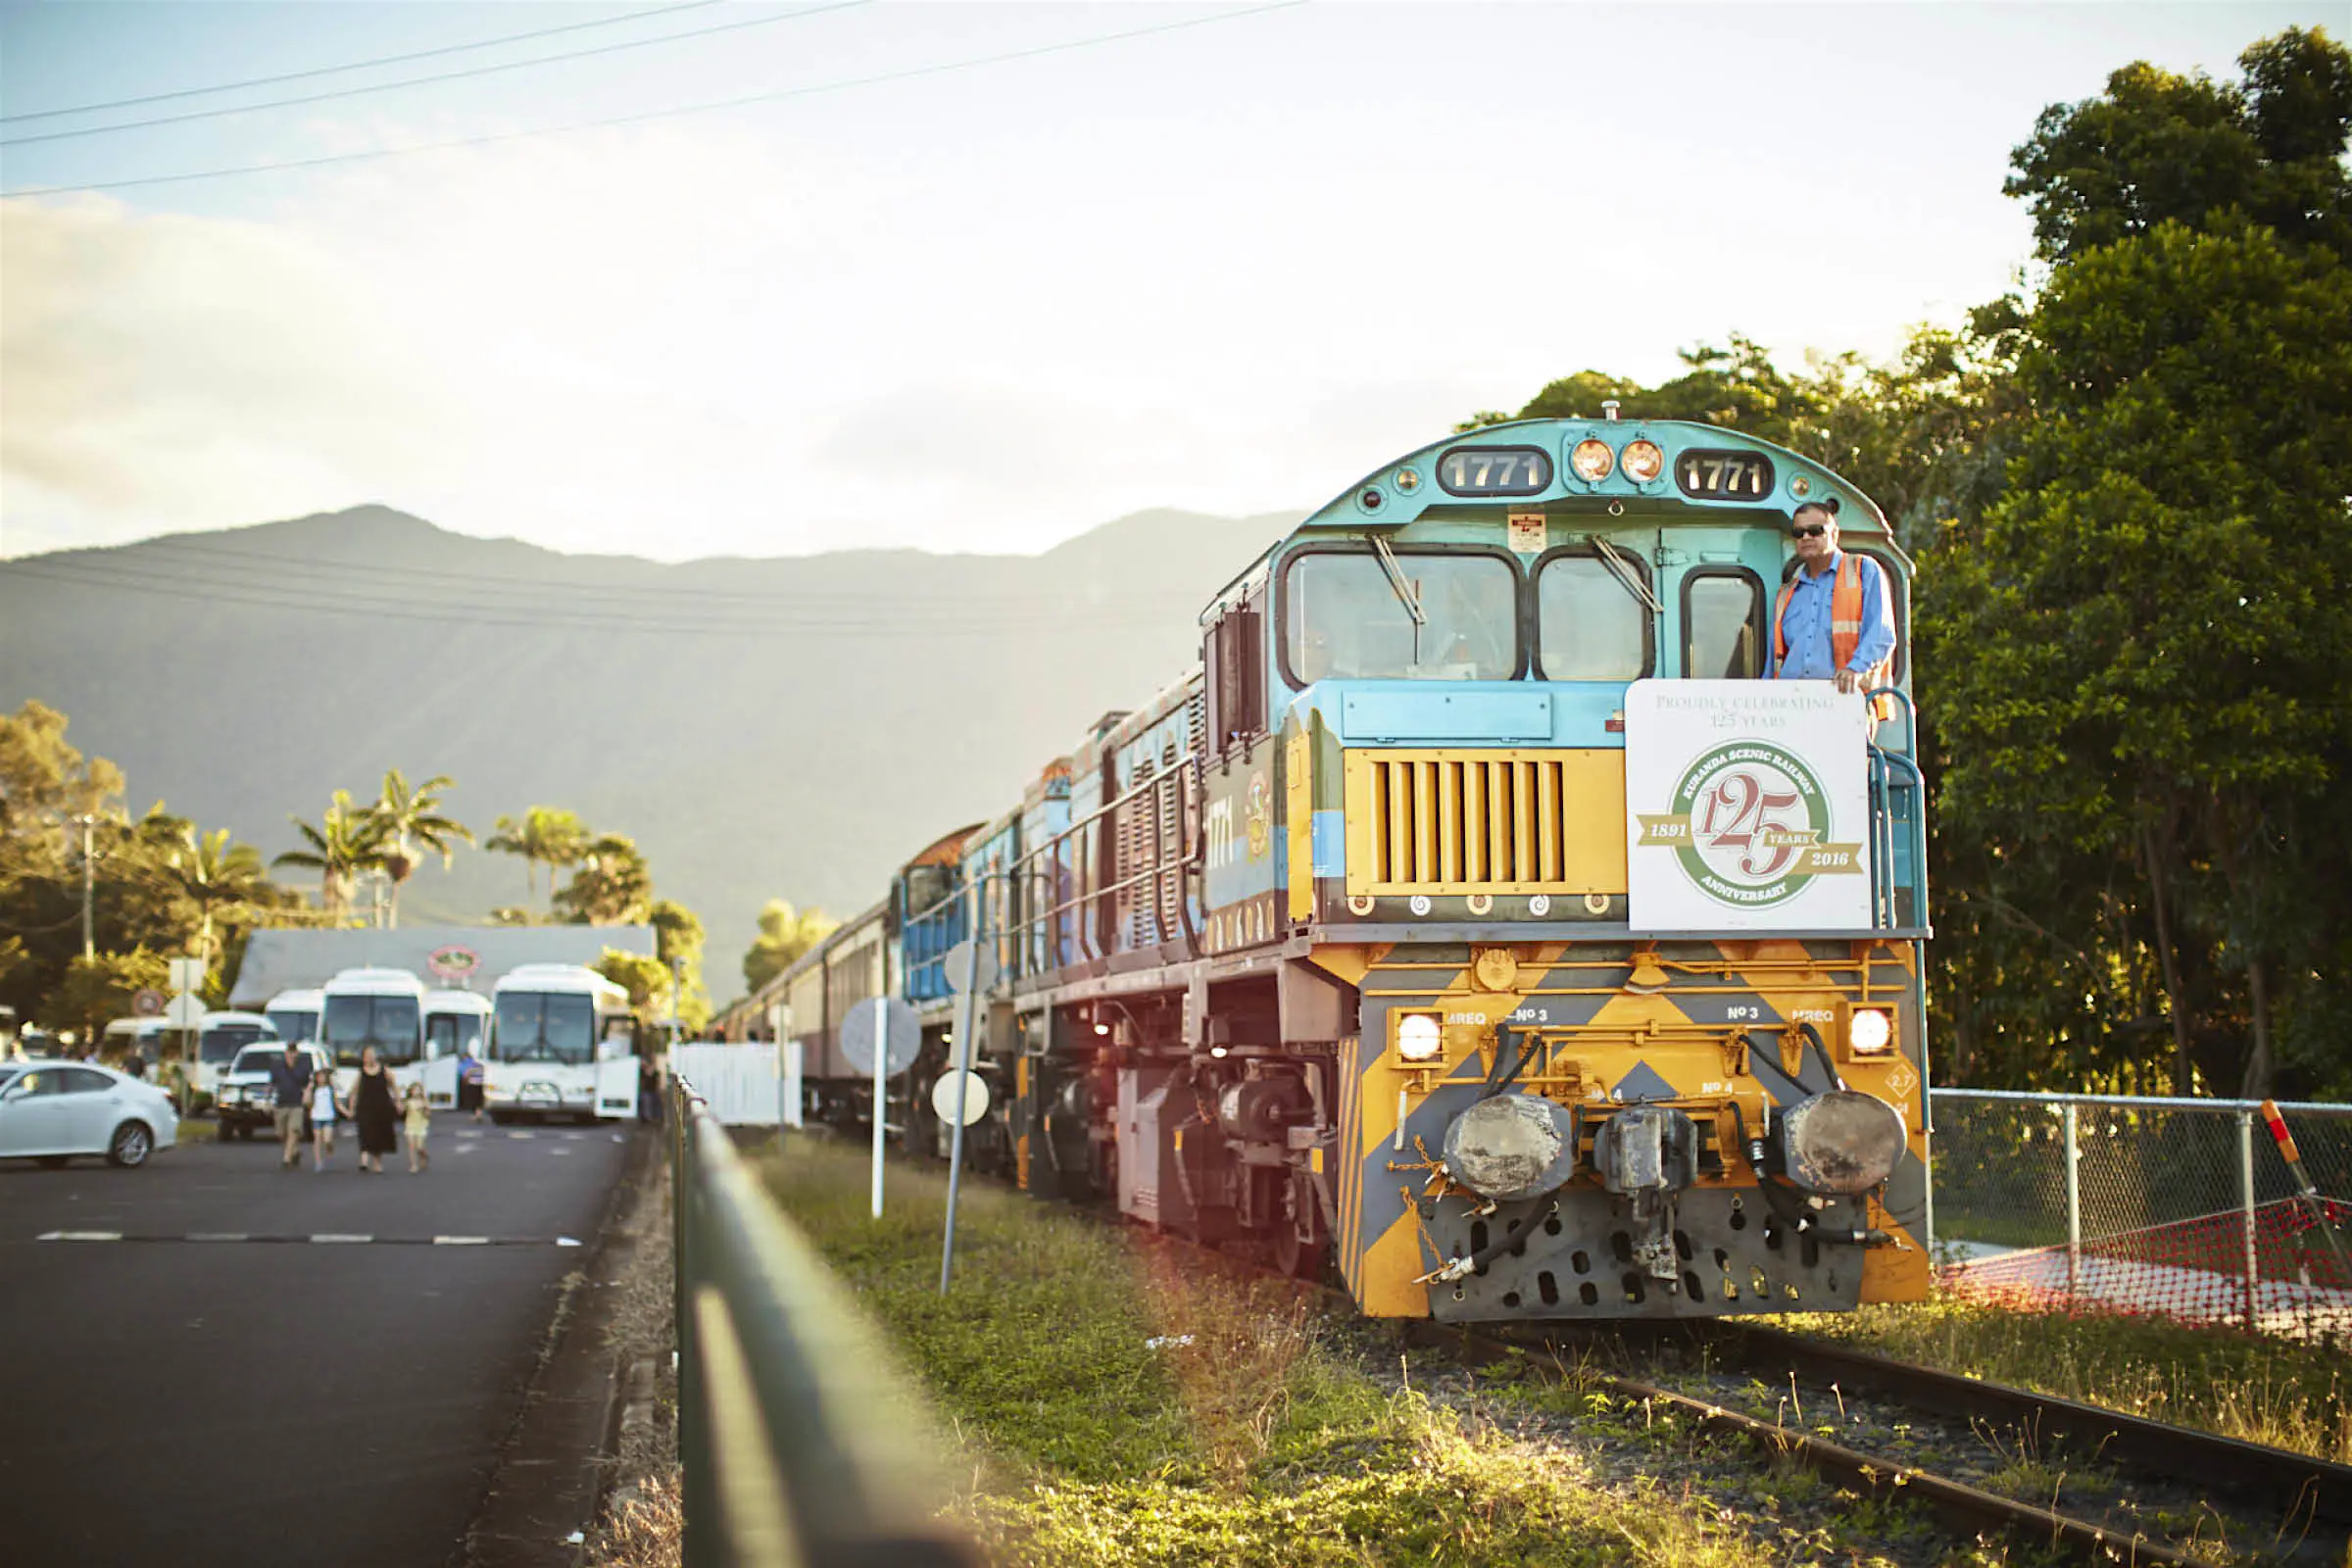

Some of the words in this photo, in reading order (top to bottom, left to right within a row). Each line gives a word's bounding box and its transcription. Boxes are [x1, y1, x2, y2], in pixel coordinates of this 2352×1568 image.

[1449, 455, 1539, 487] 1771
[1684, 459, 1761, 494] 1771
[1729, 749, 1773, 760] SCENIC
[1772, 755, 1816, 796] RAILWAY
[1650, 823, 1688, 838] 1891
[1694, 771, 1799, 877] 125
[1769, 833, 1809, 845] YEARS
[1811, 853, 1850, 866] 2016
[1701, 874, 1788, 902] ANNIVERSARY
[1539, 1009, 1548, 1021] 3
[1749, 1006, 1759, 1019] 3
[1724, 1082, 1734, 1094] 4
